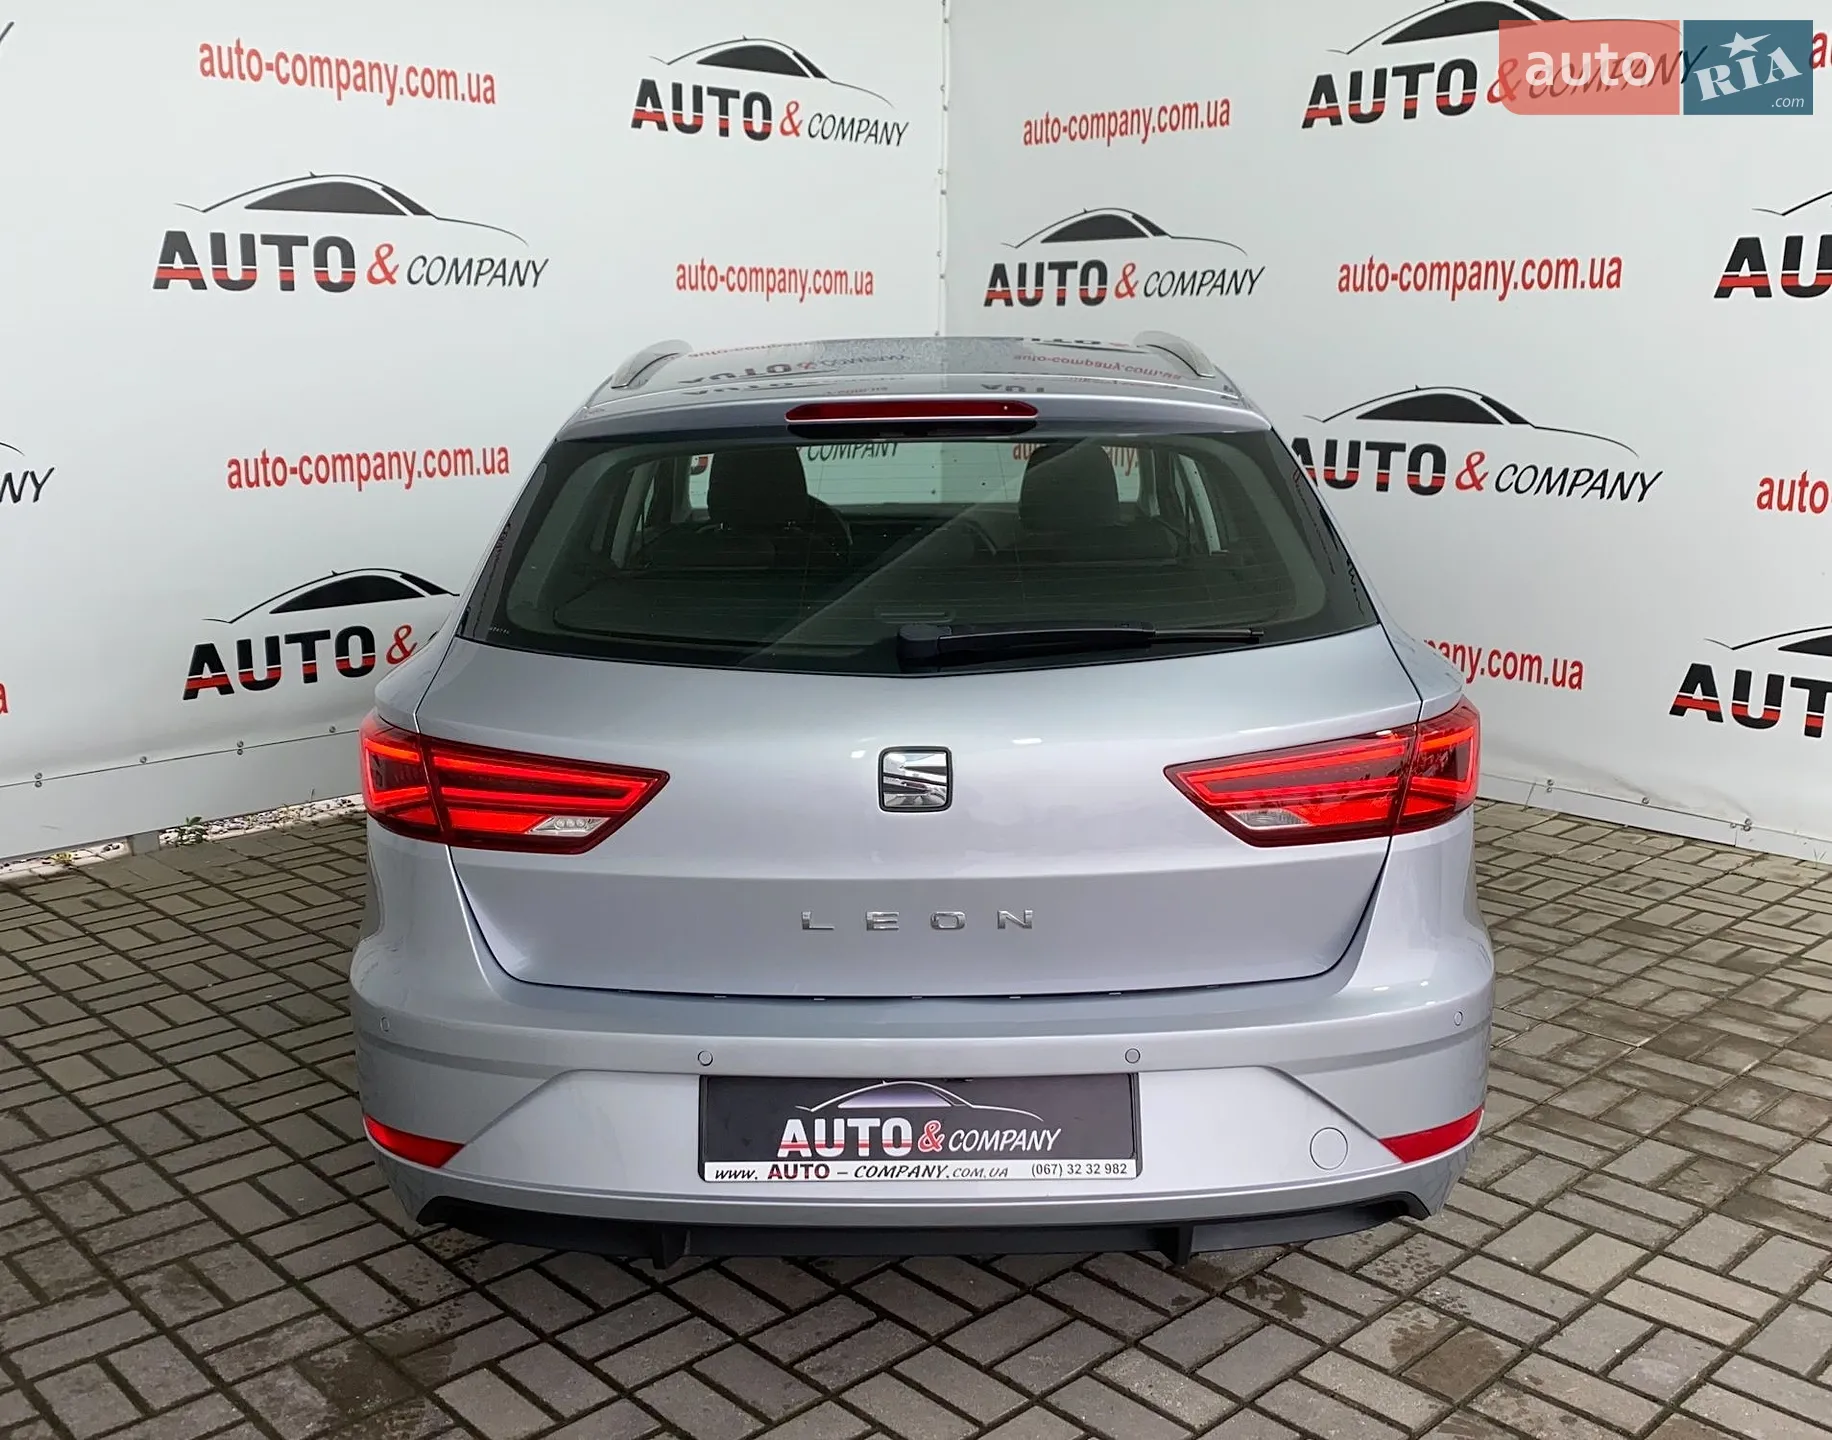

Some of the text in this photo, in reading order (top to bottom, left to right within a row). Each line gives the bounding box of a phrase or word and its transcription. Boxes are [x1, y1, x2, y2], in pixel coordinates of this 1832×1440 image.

[198, 38, 496, 105] auto-company.com.ua
[1809, 32, 1832, 68] a
[632, 79, 909, 147] AUTO & COMPANY
[1302, 59, 1478, 129] AUTO
[1023, 98, 1231, 146] auto-company.com.ua
[153, 230, 549, 293] AUTO & COMPANY
[676, 257, 874, 303] auto-company.com.ua
[984, 259, 1266, 307] AUTO & COMPANY
[1338, 256, 1622, 301] auto-company.com.ua
[227, 446, 509, 492] auto-company.com.ua
[1291, 438, 1664, 503] AUTO & COMPANY
[1756, 469, 1832, 514] auto
[183, 624, 418, 700] AUTO &
[1669, 662, 1832, 739] AUT
[801, 909, 1033, 931] LEON
[777, 1117, 1062, 1158] AUTO & COMPANY
[767, 1163, 830, 1180] AUTO
[1031, 1162, 1128, 1178] (067) 32 32 982
